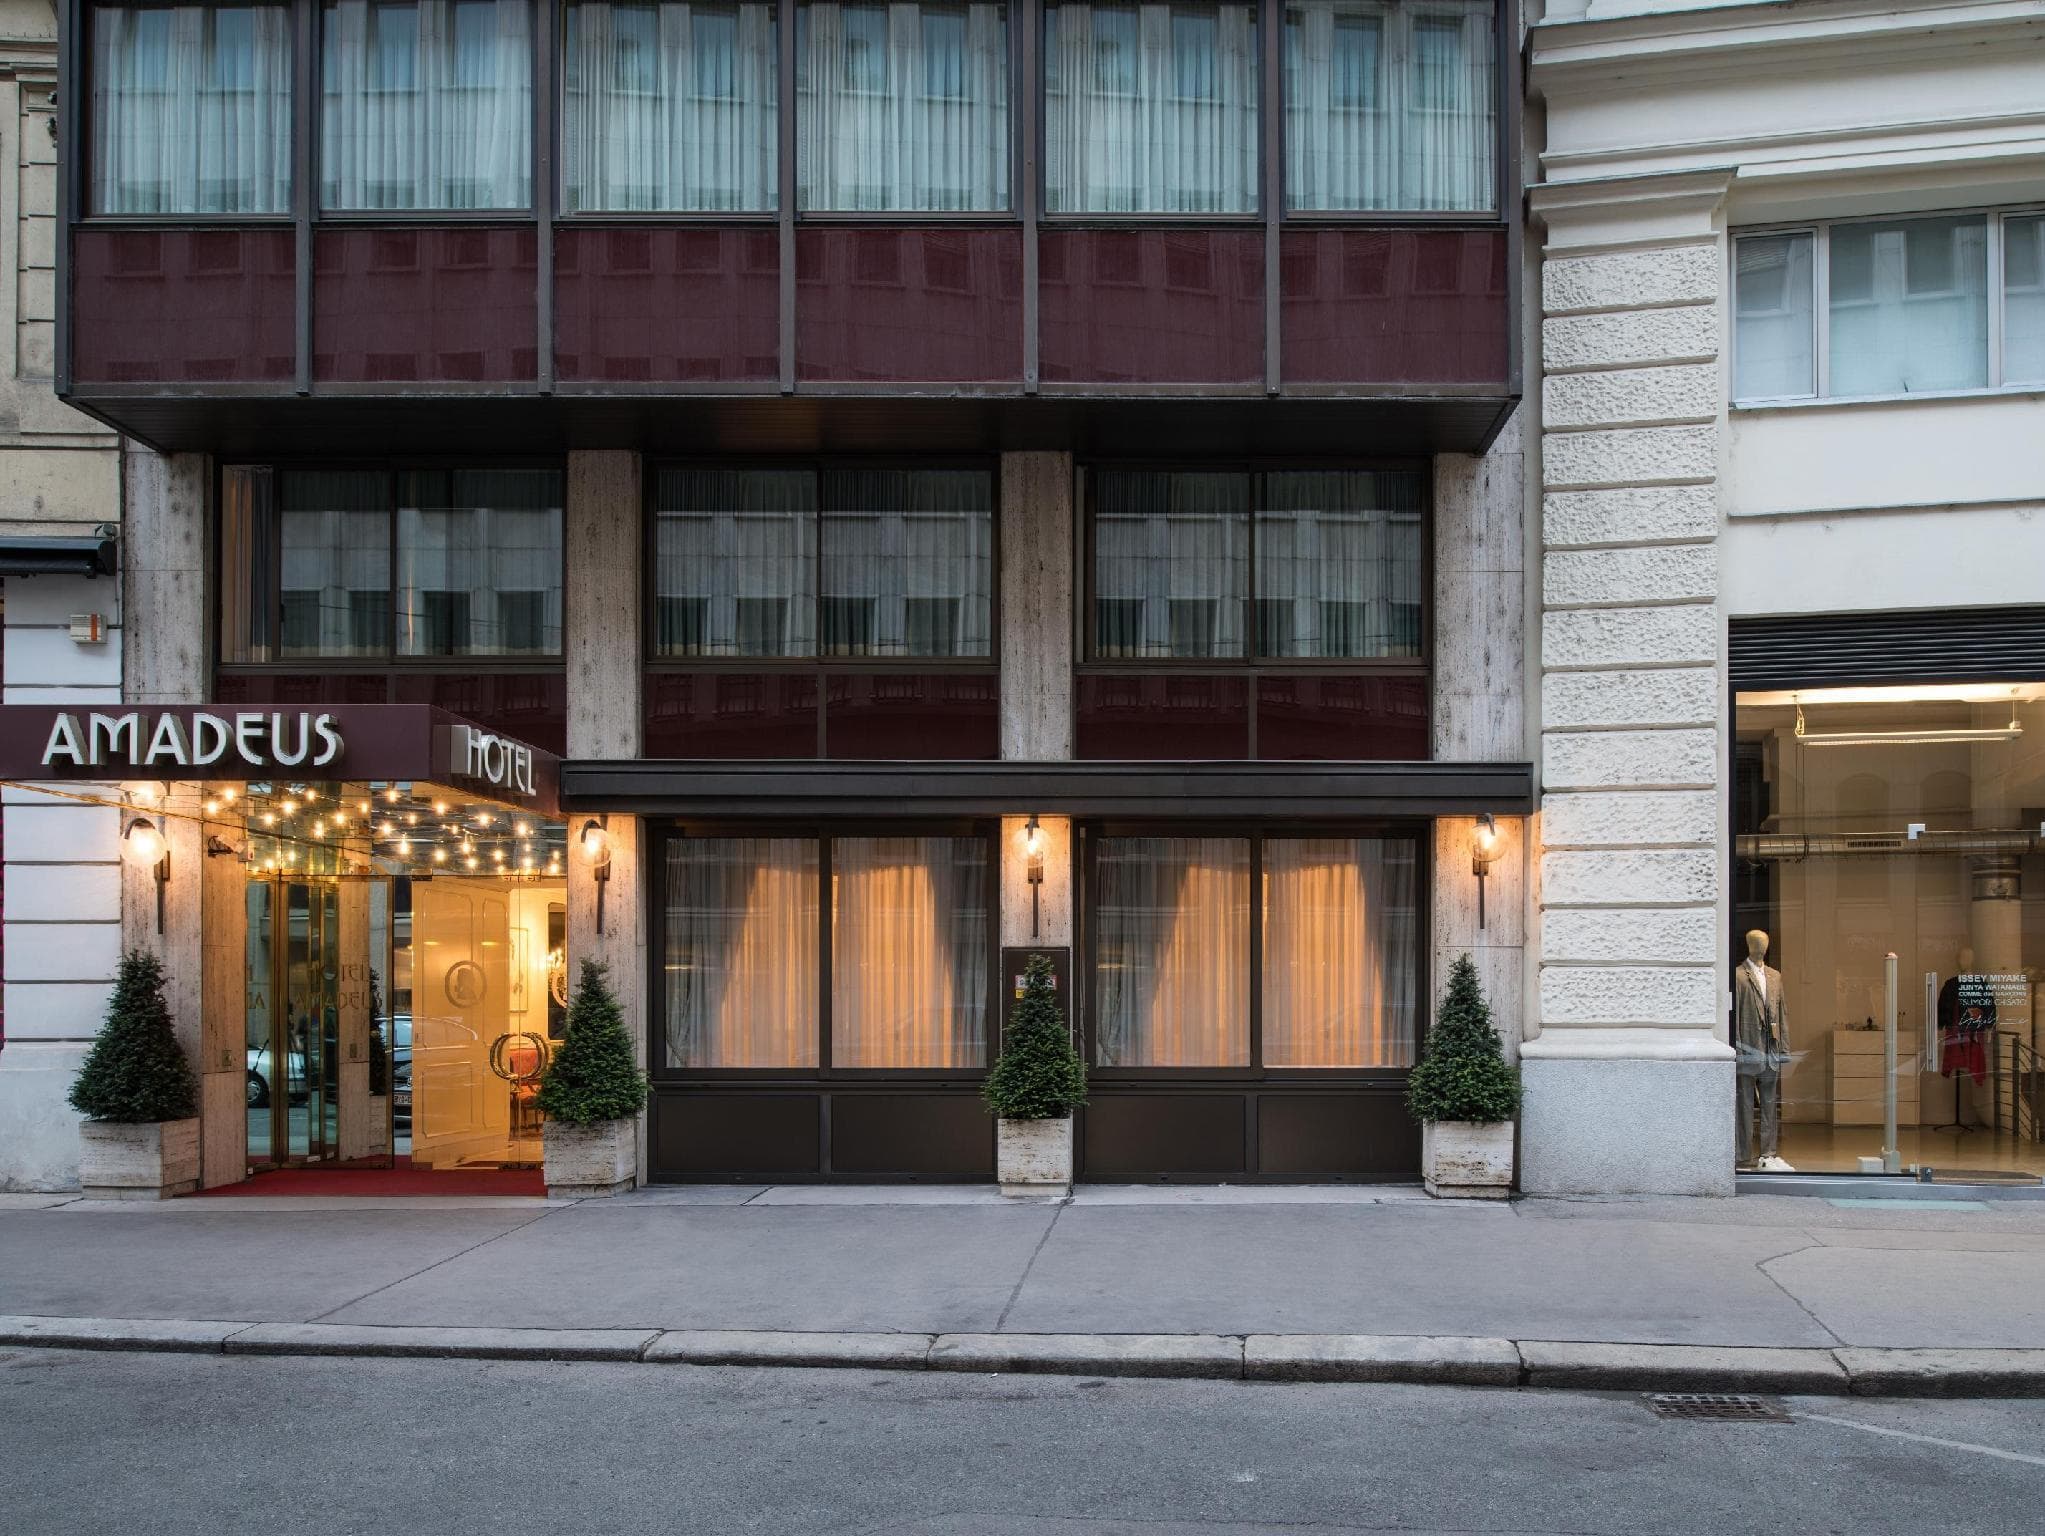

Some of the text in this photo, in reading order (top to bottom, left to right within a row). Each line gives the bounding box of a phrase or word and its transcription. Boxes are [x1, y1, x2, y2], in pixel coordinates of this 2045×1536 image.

[41, 712, 340, 767] AMADEUS
[464, 724, 537, 797] HOTEL
[1958, 974, 2027, 983] ISSEY MIYAKE
